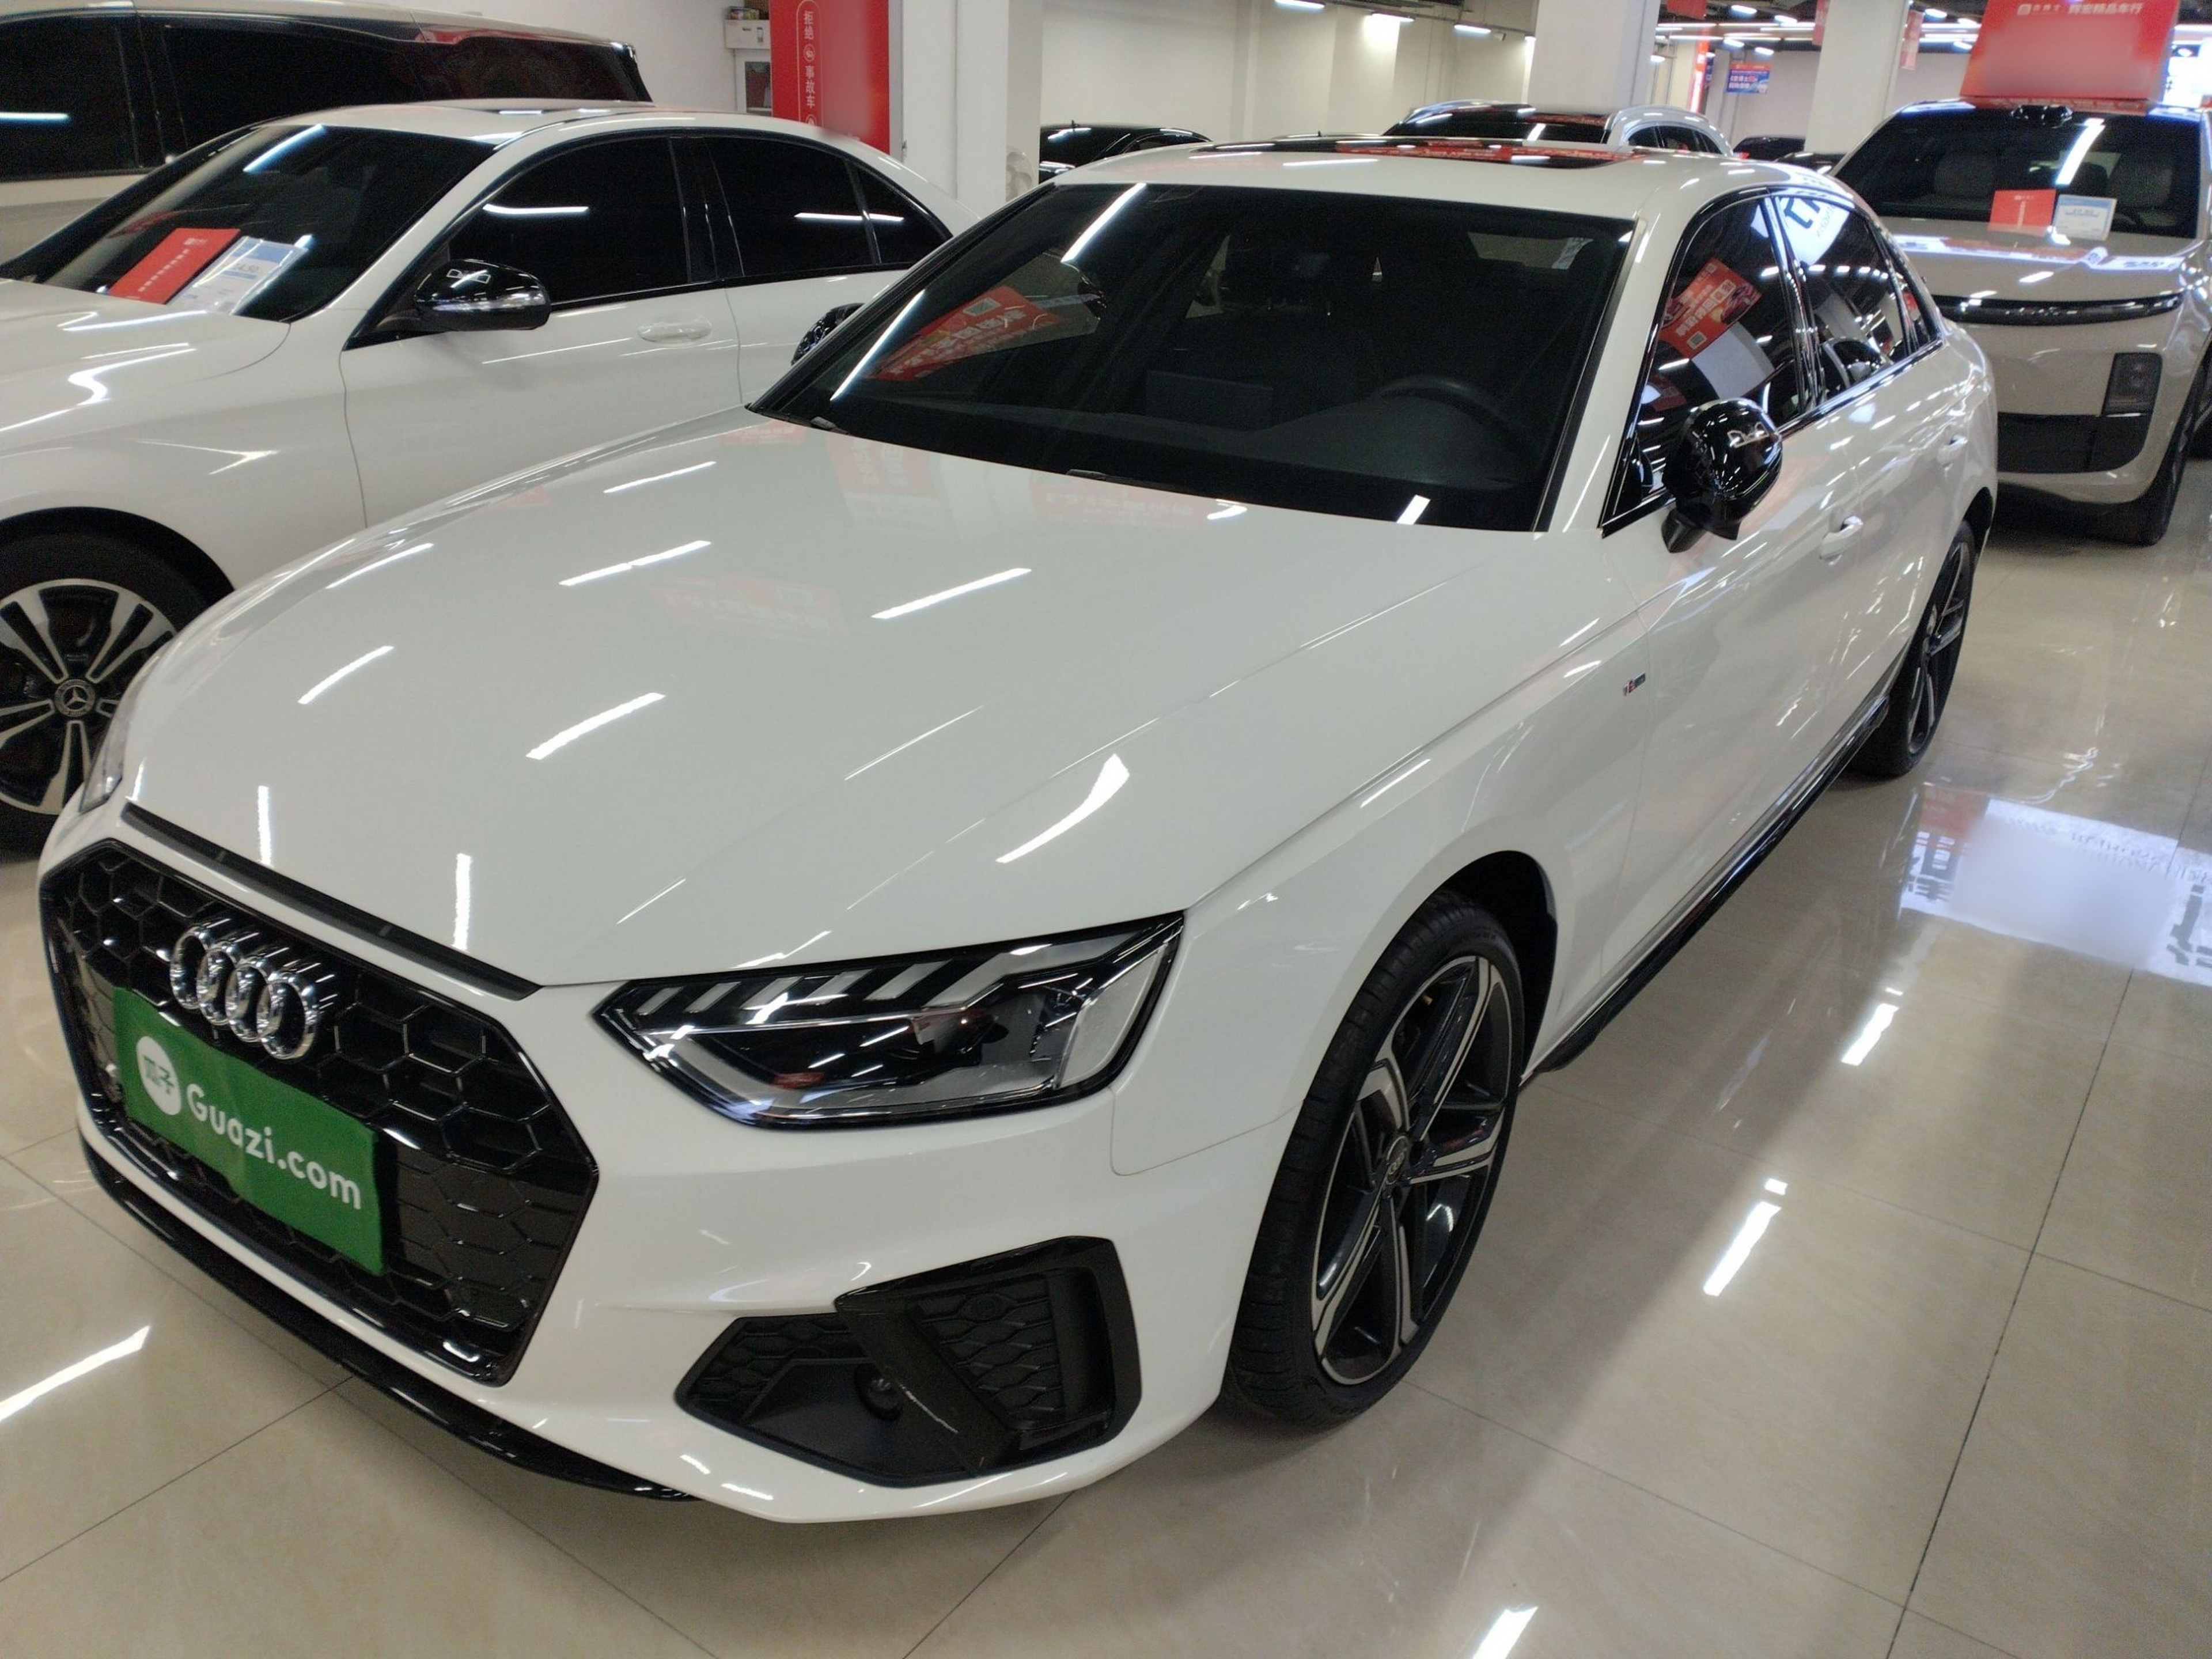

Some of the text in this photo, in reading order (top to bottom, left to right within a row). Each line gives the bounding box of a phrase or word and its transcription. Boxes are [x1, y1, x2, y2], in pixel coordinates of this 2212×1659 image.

[805, 65, 816, 109] 事故车
[186, 1083, 361, 1210] Guazi.com
